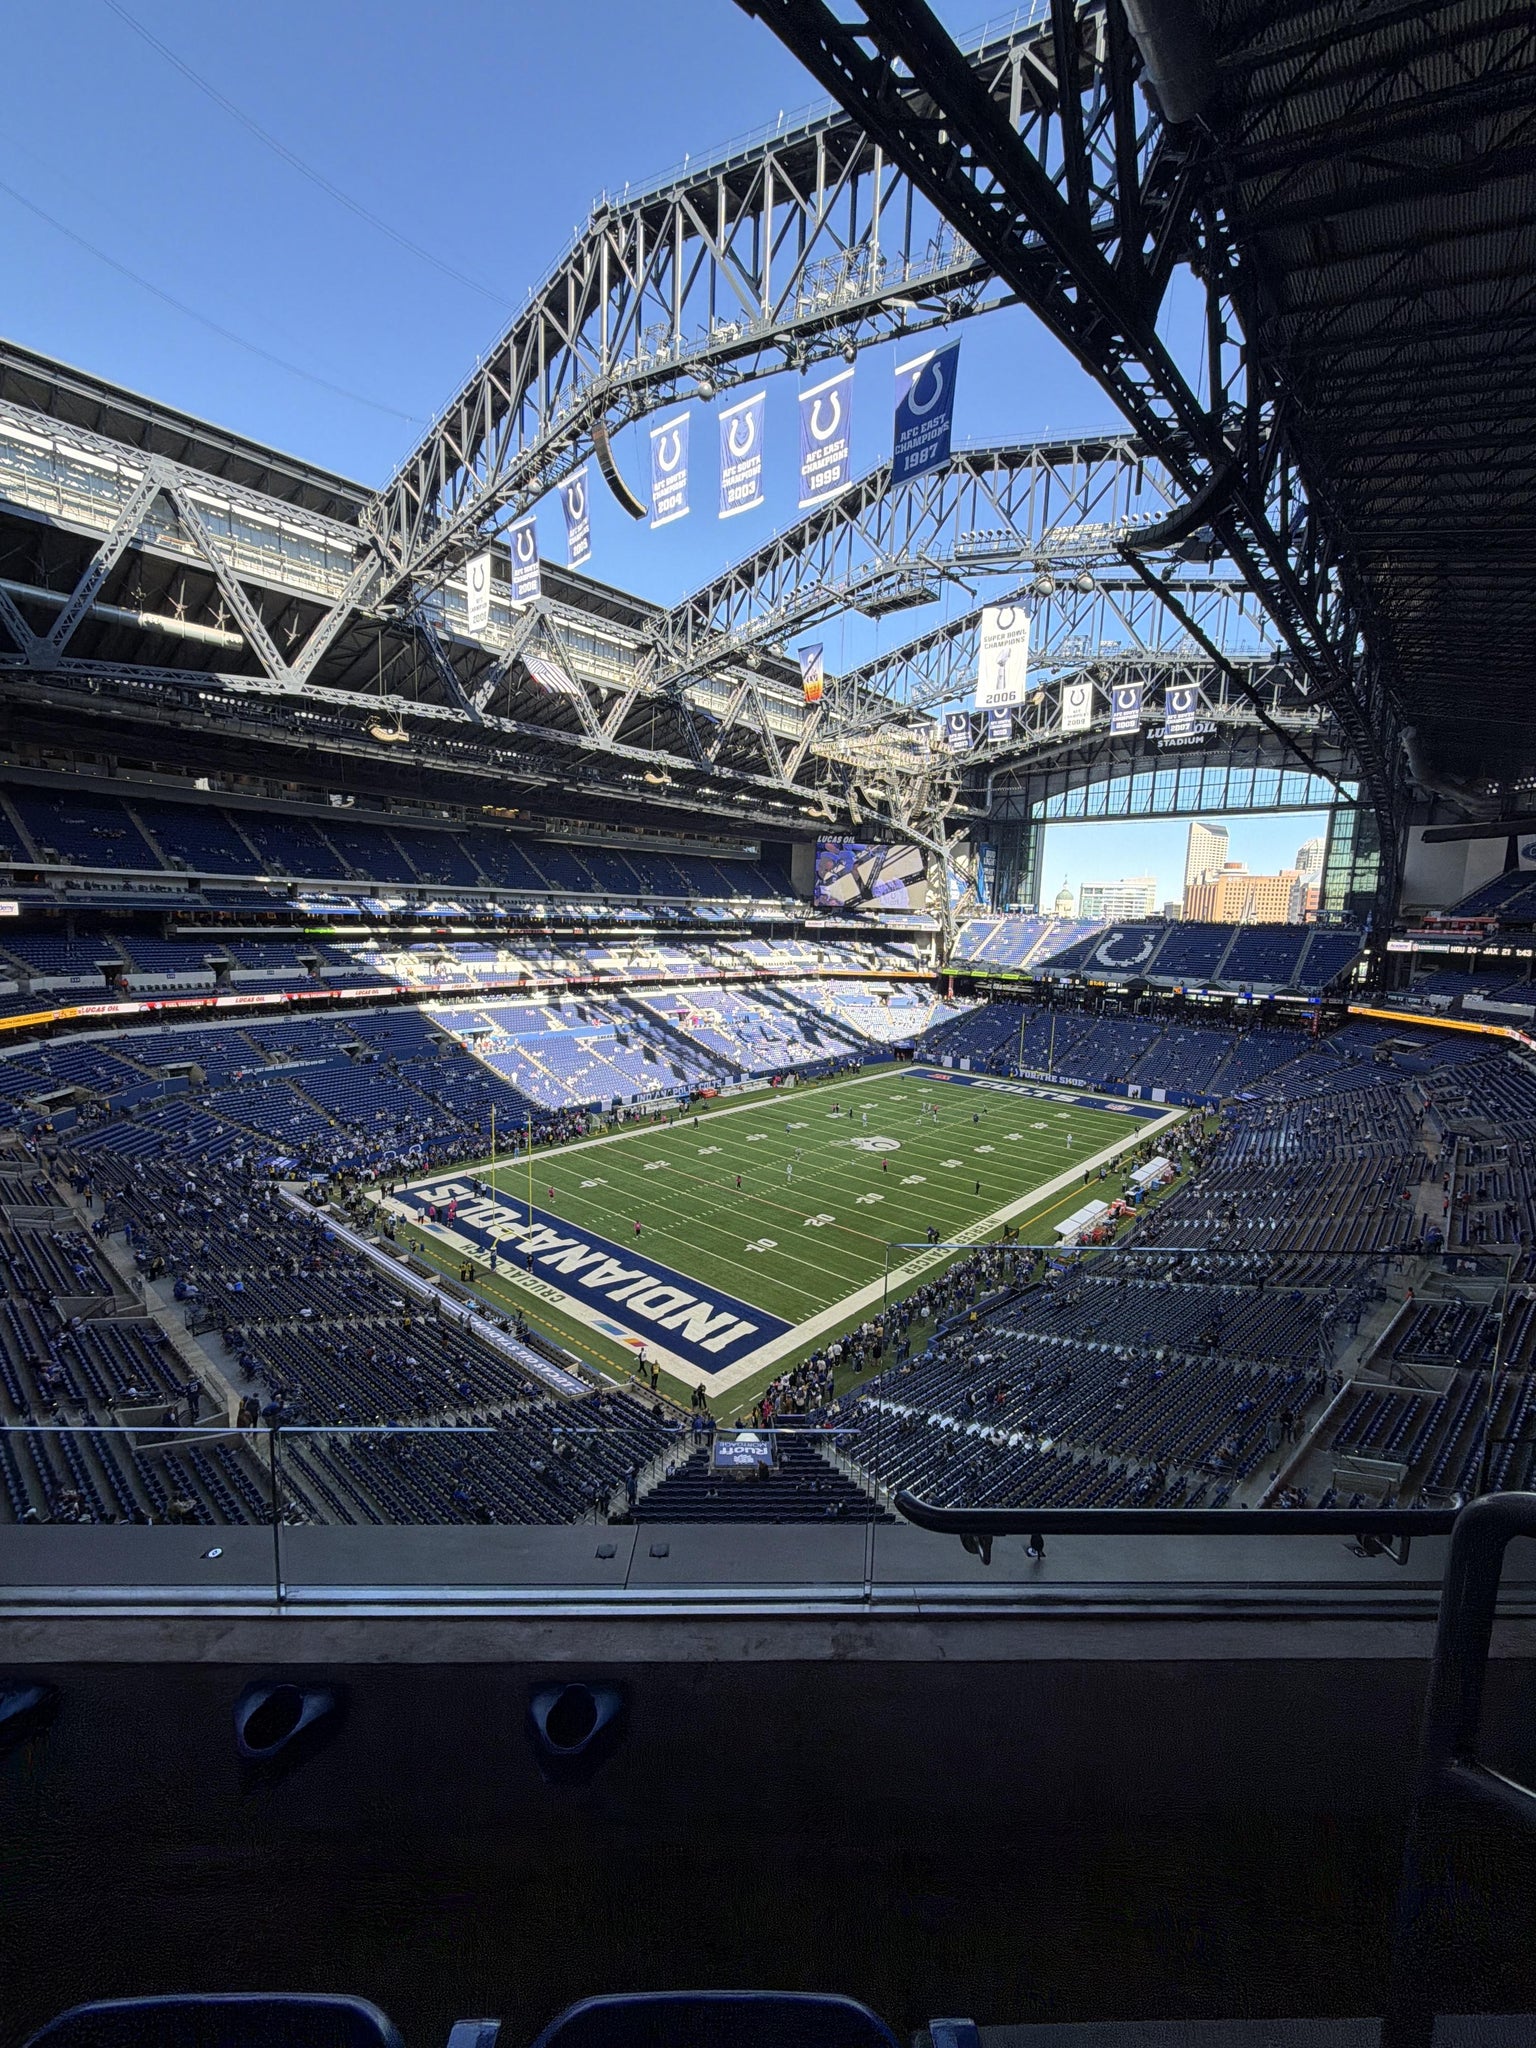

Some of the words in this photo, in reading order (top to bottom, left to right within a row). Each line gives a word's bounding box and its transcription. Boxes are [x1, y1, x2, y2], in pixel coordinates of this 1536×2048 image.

[895, 421, 949, 455] CHAMPIONS
[900, 426, 919, 442] AFC
[921, 413, 946, 433] EAST
[802, 448, 848, 475] CHAMPIONS
[806, 449, 822, 463] AFC
[823, 439, 845, 456] EAST
[904, 442, 938, 471] 1987
[811, 465, 840, 490] 1999
[728, 480, 755, 503] 2003
[658, 492, 682, 513] 2004
[984, 633, 1005, 642] SUPER
[1007, 629, 1026, 638] BOWL
[984, 636, 1025, 649] CHAMPIONS
[986, 691, 1016, 704] 2006
[1170, 723, 1190, 732] 2007
[1194, 721, 1217, 735] OIL
[1157, 736, 1204, 748] STADIUM
[1483, 947, 1498, 955] JAX
[1502, 948, 1511, 956] 21
[1516, 949, 1532, 957] 1:43
[1020, 1070, 1037, 1079] FOR
[1039, 1073, 1057, 1083] THE
[1059, 1076, 1084, 1087] SHOE
[971, 1081, 1081, 1103] COLTS
[804, 1213, 836, 1227] 20
[746, 1238, 778, 1252] 10
[414, 1183, 760, 1353] INDIANAPOLIS
[901, 1247, 951, 1275] CANCER
[502, 1266, 566, 1303] CRUCIAL
[471, 1319, 520, 1351] STADIUM
[516, 1350, 539, 1366] OIL
[534, 1363, 576, 1388] LUCAS
[719, 1447, 768, 1455] Ruoff
